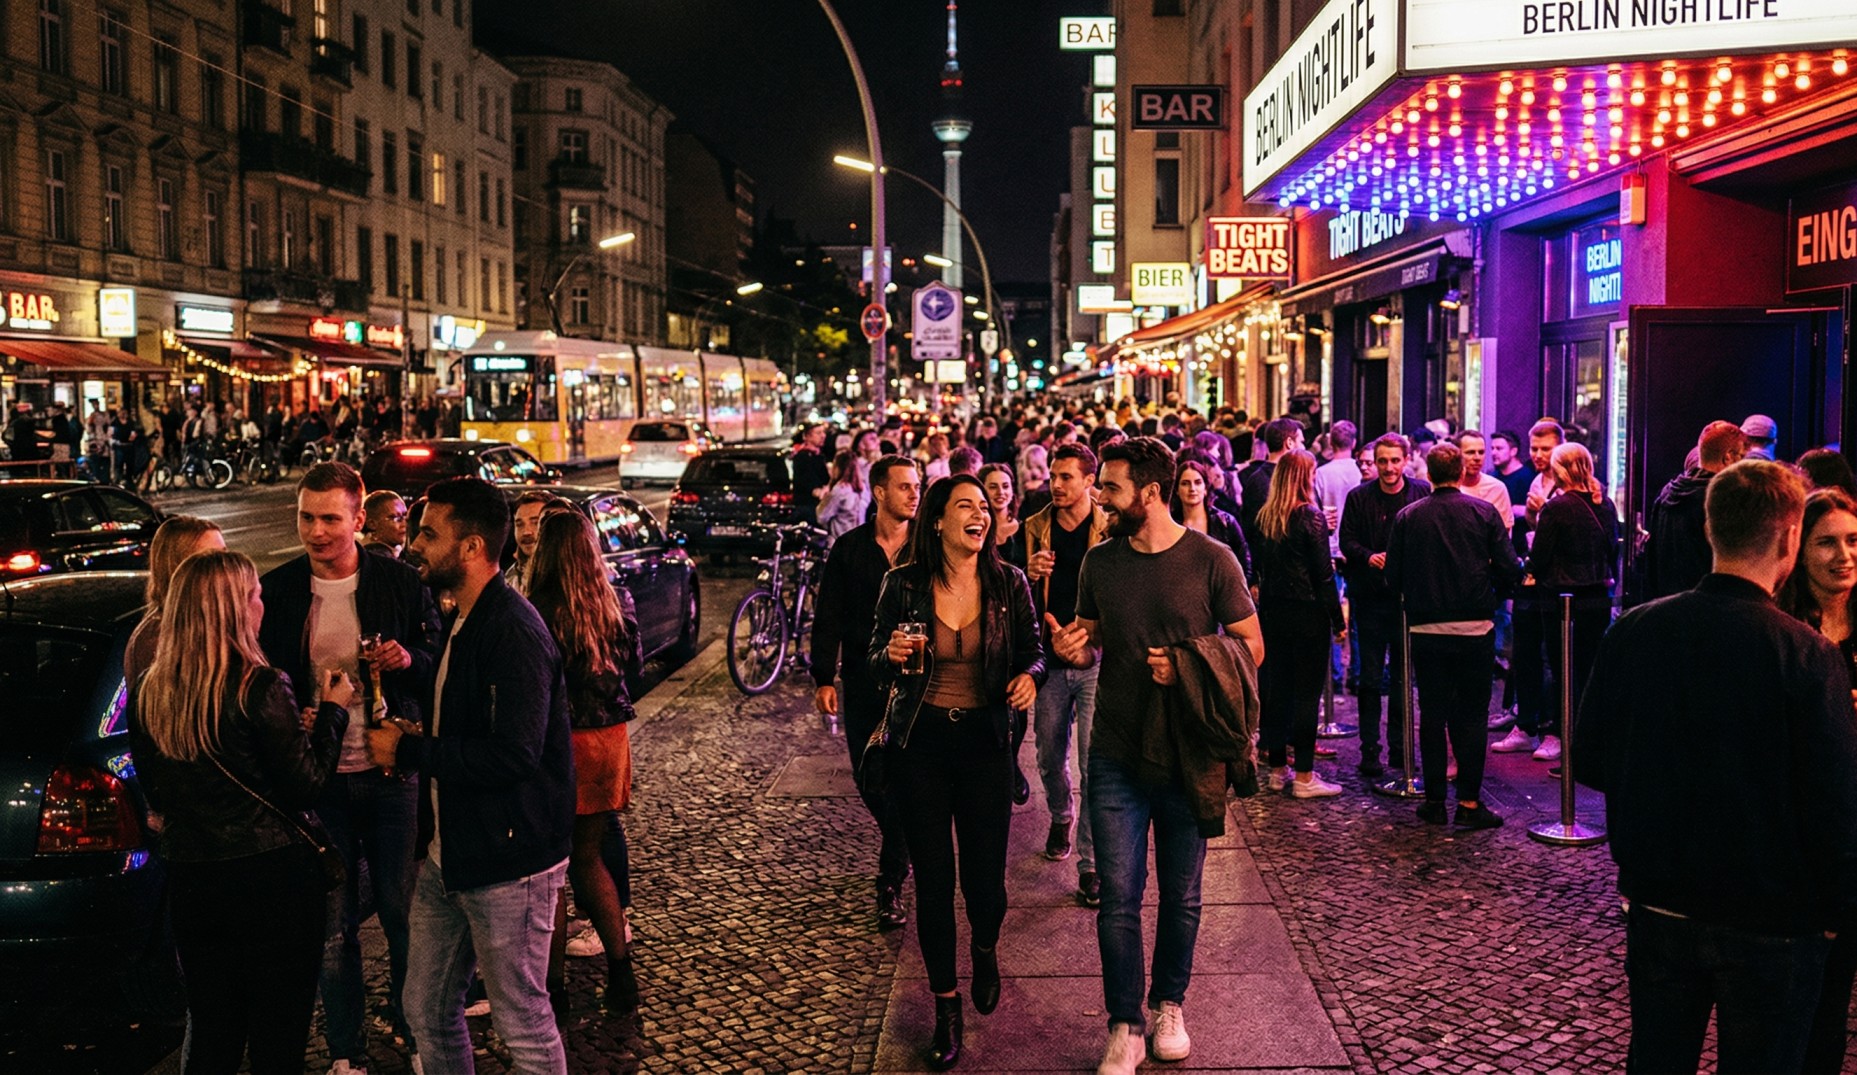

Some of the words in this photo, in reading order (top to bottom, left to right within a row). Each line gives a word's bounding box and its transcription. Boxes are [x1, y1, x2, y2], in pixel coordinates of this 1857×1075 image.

[1523, 0, 1620, 35] BERLIN
[1631, 0, 1779, 28] NIGHTLIFE
[1255, 70, 1295, 167] BERLIN
[1297, 0, 1376, 130] NIGHTLIFE
[1141, 94, 1214, 121] BAR
[1213, 223, 1289, 249] TIGHT
[1328, 210, 1361, 260] TIGHT
[1209, 248, 1289, 274] BEATS
[1586, 239, 1622, 273] BERLIN
[1138, 269, 1184, 287] BIER
